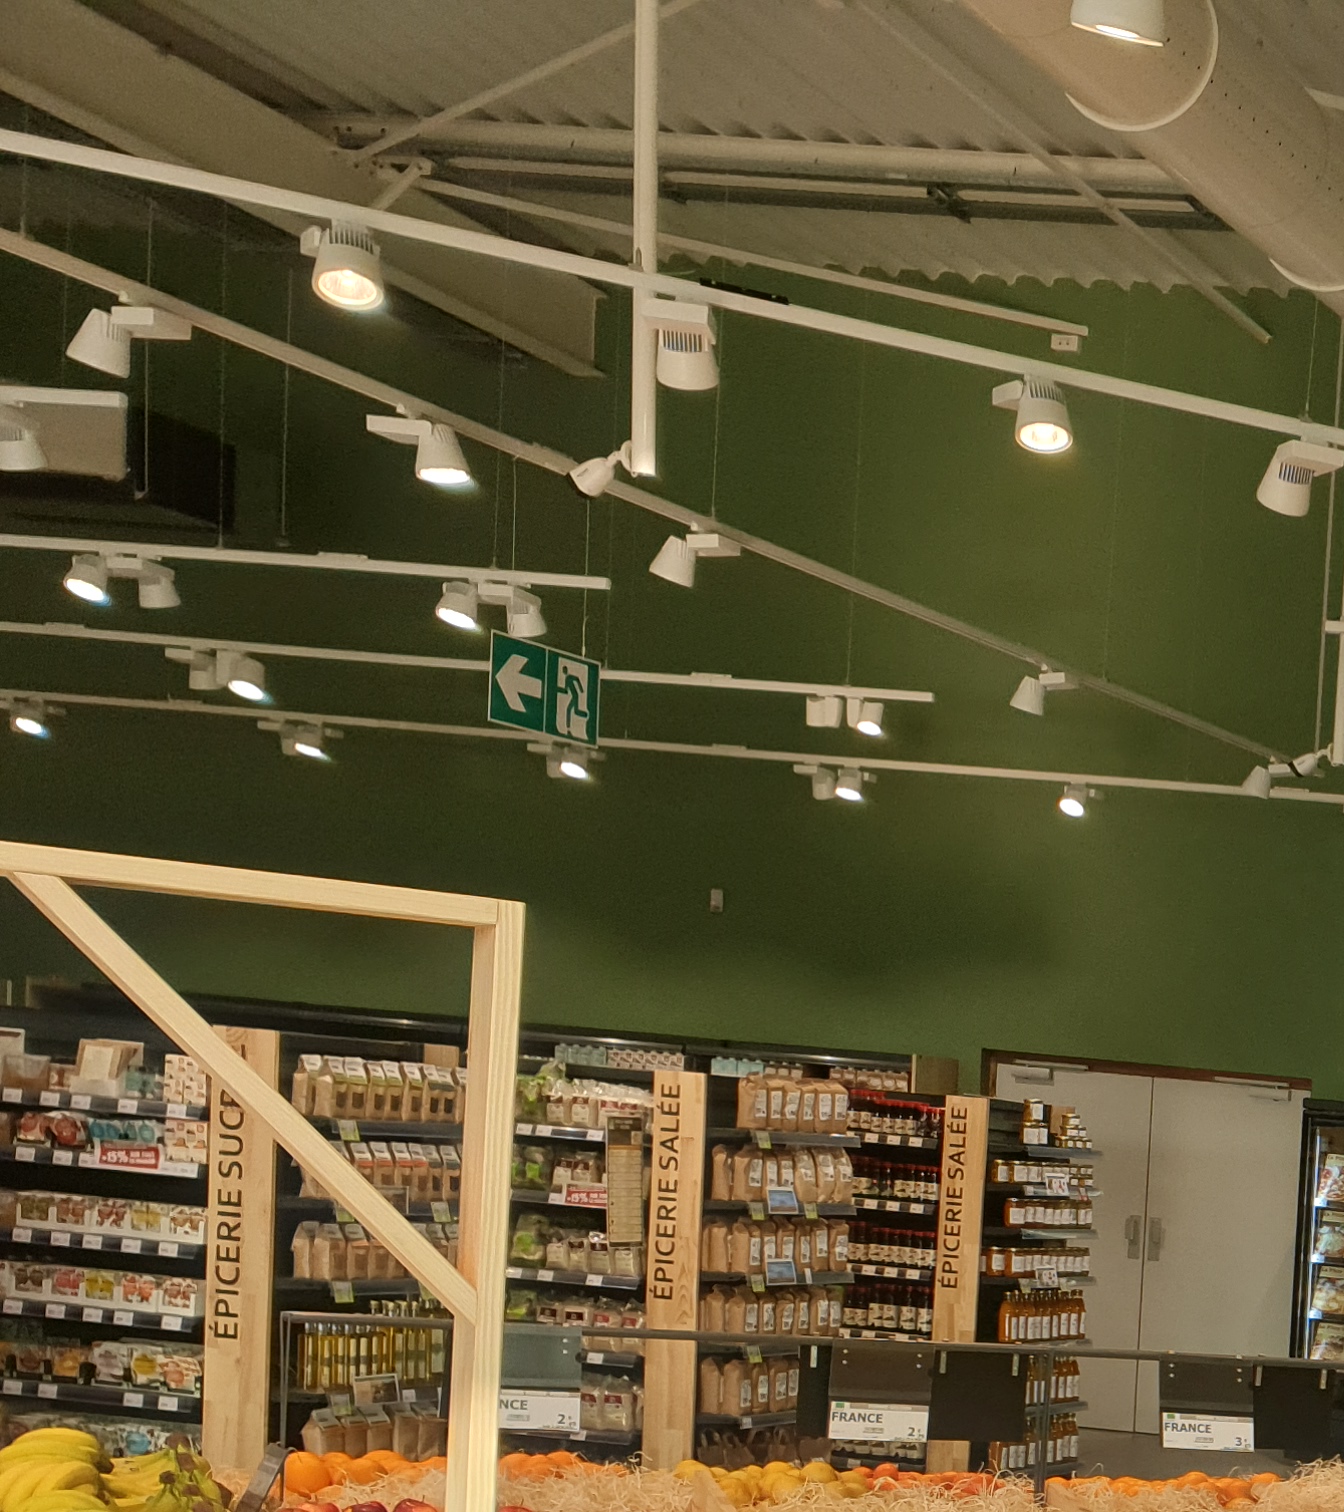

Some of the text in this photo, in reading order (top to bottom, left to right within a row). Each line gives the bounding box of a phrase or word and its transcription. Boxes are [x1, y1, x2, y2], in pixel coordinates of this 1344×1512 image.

[208, 1188, 242, 1340] ÉPICERIE
[649, 1083, 681, 1300] ÉPICERIE SALÉE
[937, 1107, 968, 1289] ÉPICERIE SALÉE
[831, 1411, 883, 1424] FRANCE
[1164, 1422, 1212, 1434] FRANCE
